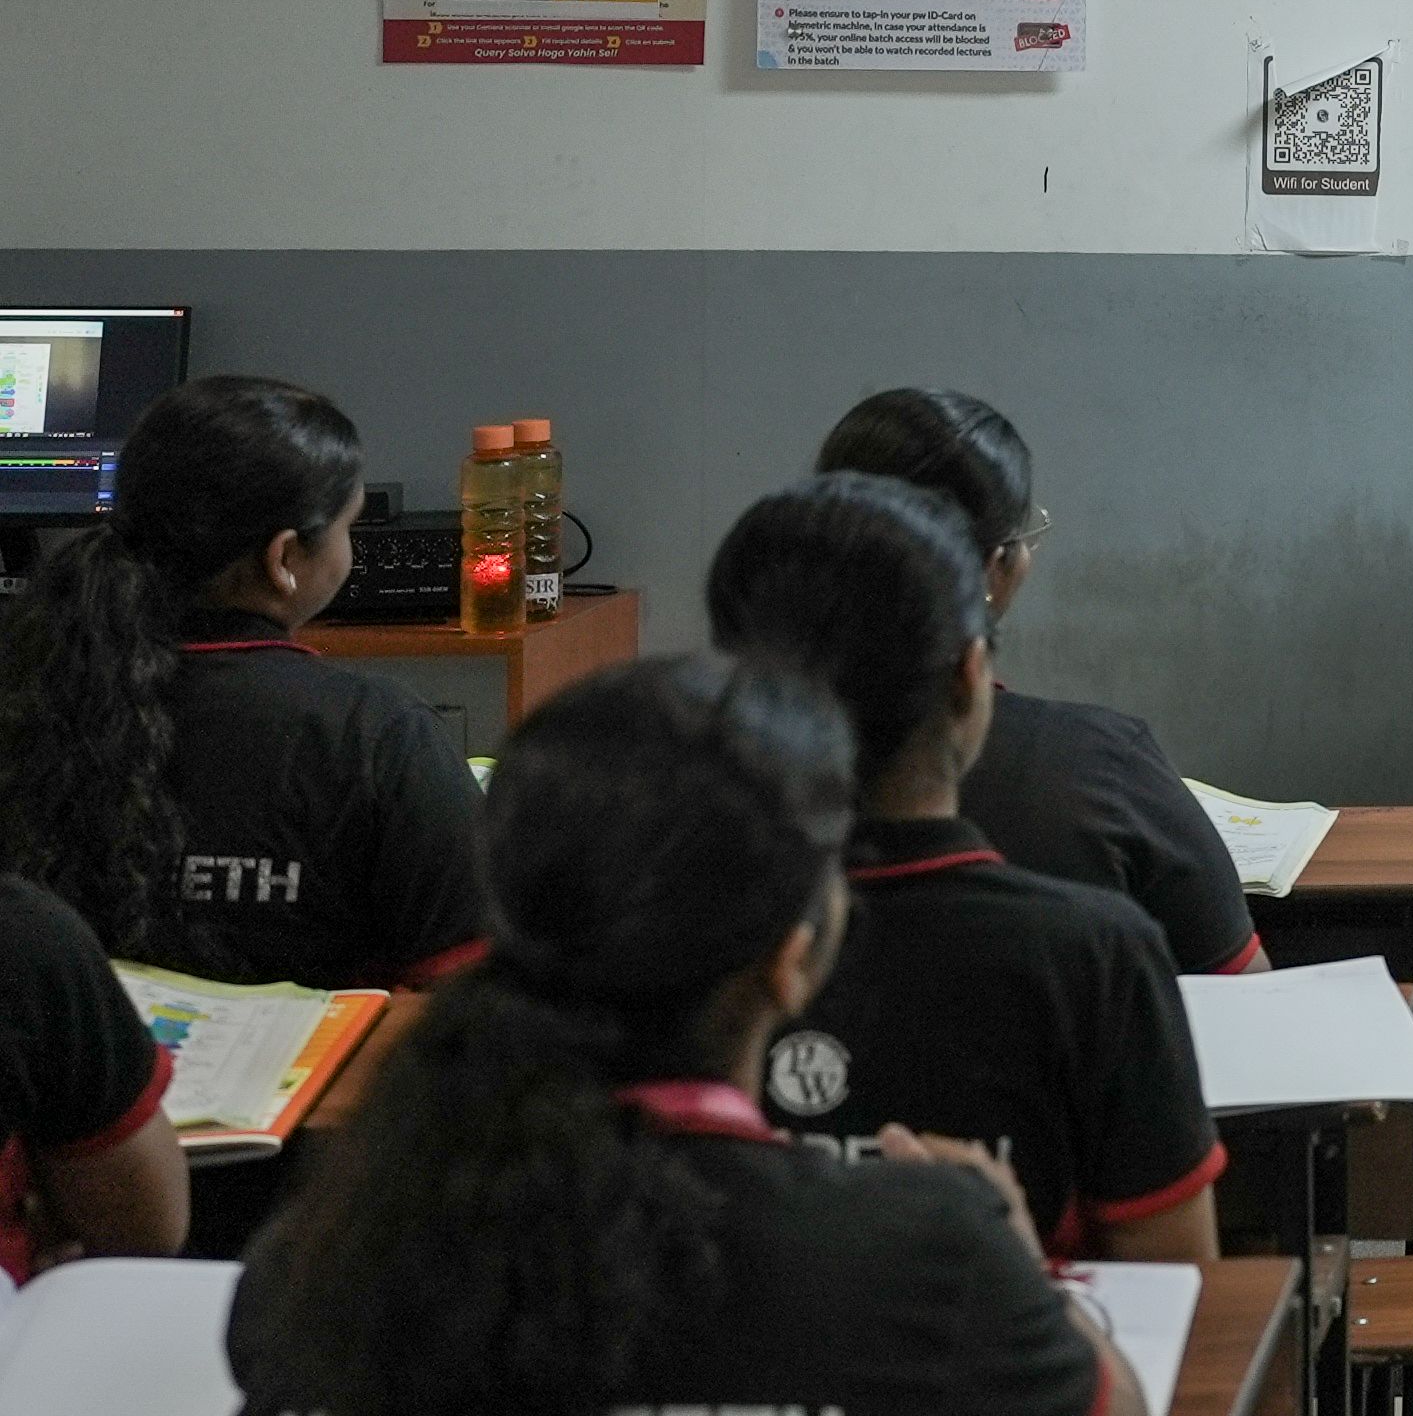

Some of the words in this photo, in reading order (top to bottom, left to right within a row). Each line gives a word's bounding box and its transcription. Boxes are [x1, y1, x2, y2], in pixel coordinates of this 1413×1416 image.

[474, 48, 506, 59] Query
[508, 48, 536, 57] Solve
[537, 48, 565, 59] Hoga
[567, 47, 596, 57] Yahin
[1273, 176, 1297, 189] Wifi
[1300, 176, 1318, 190] for
[1320, 177, 1370, 190] Student
